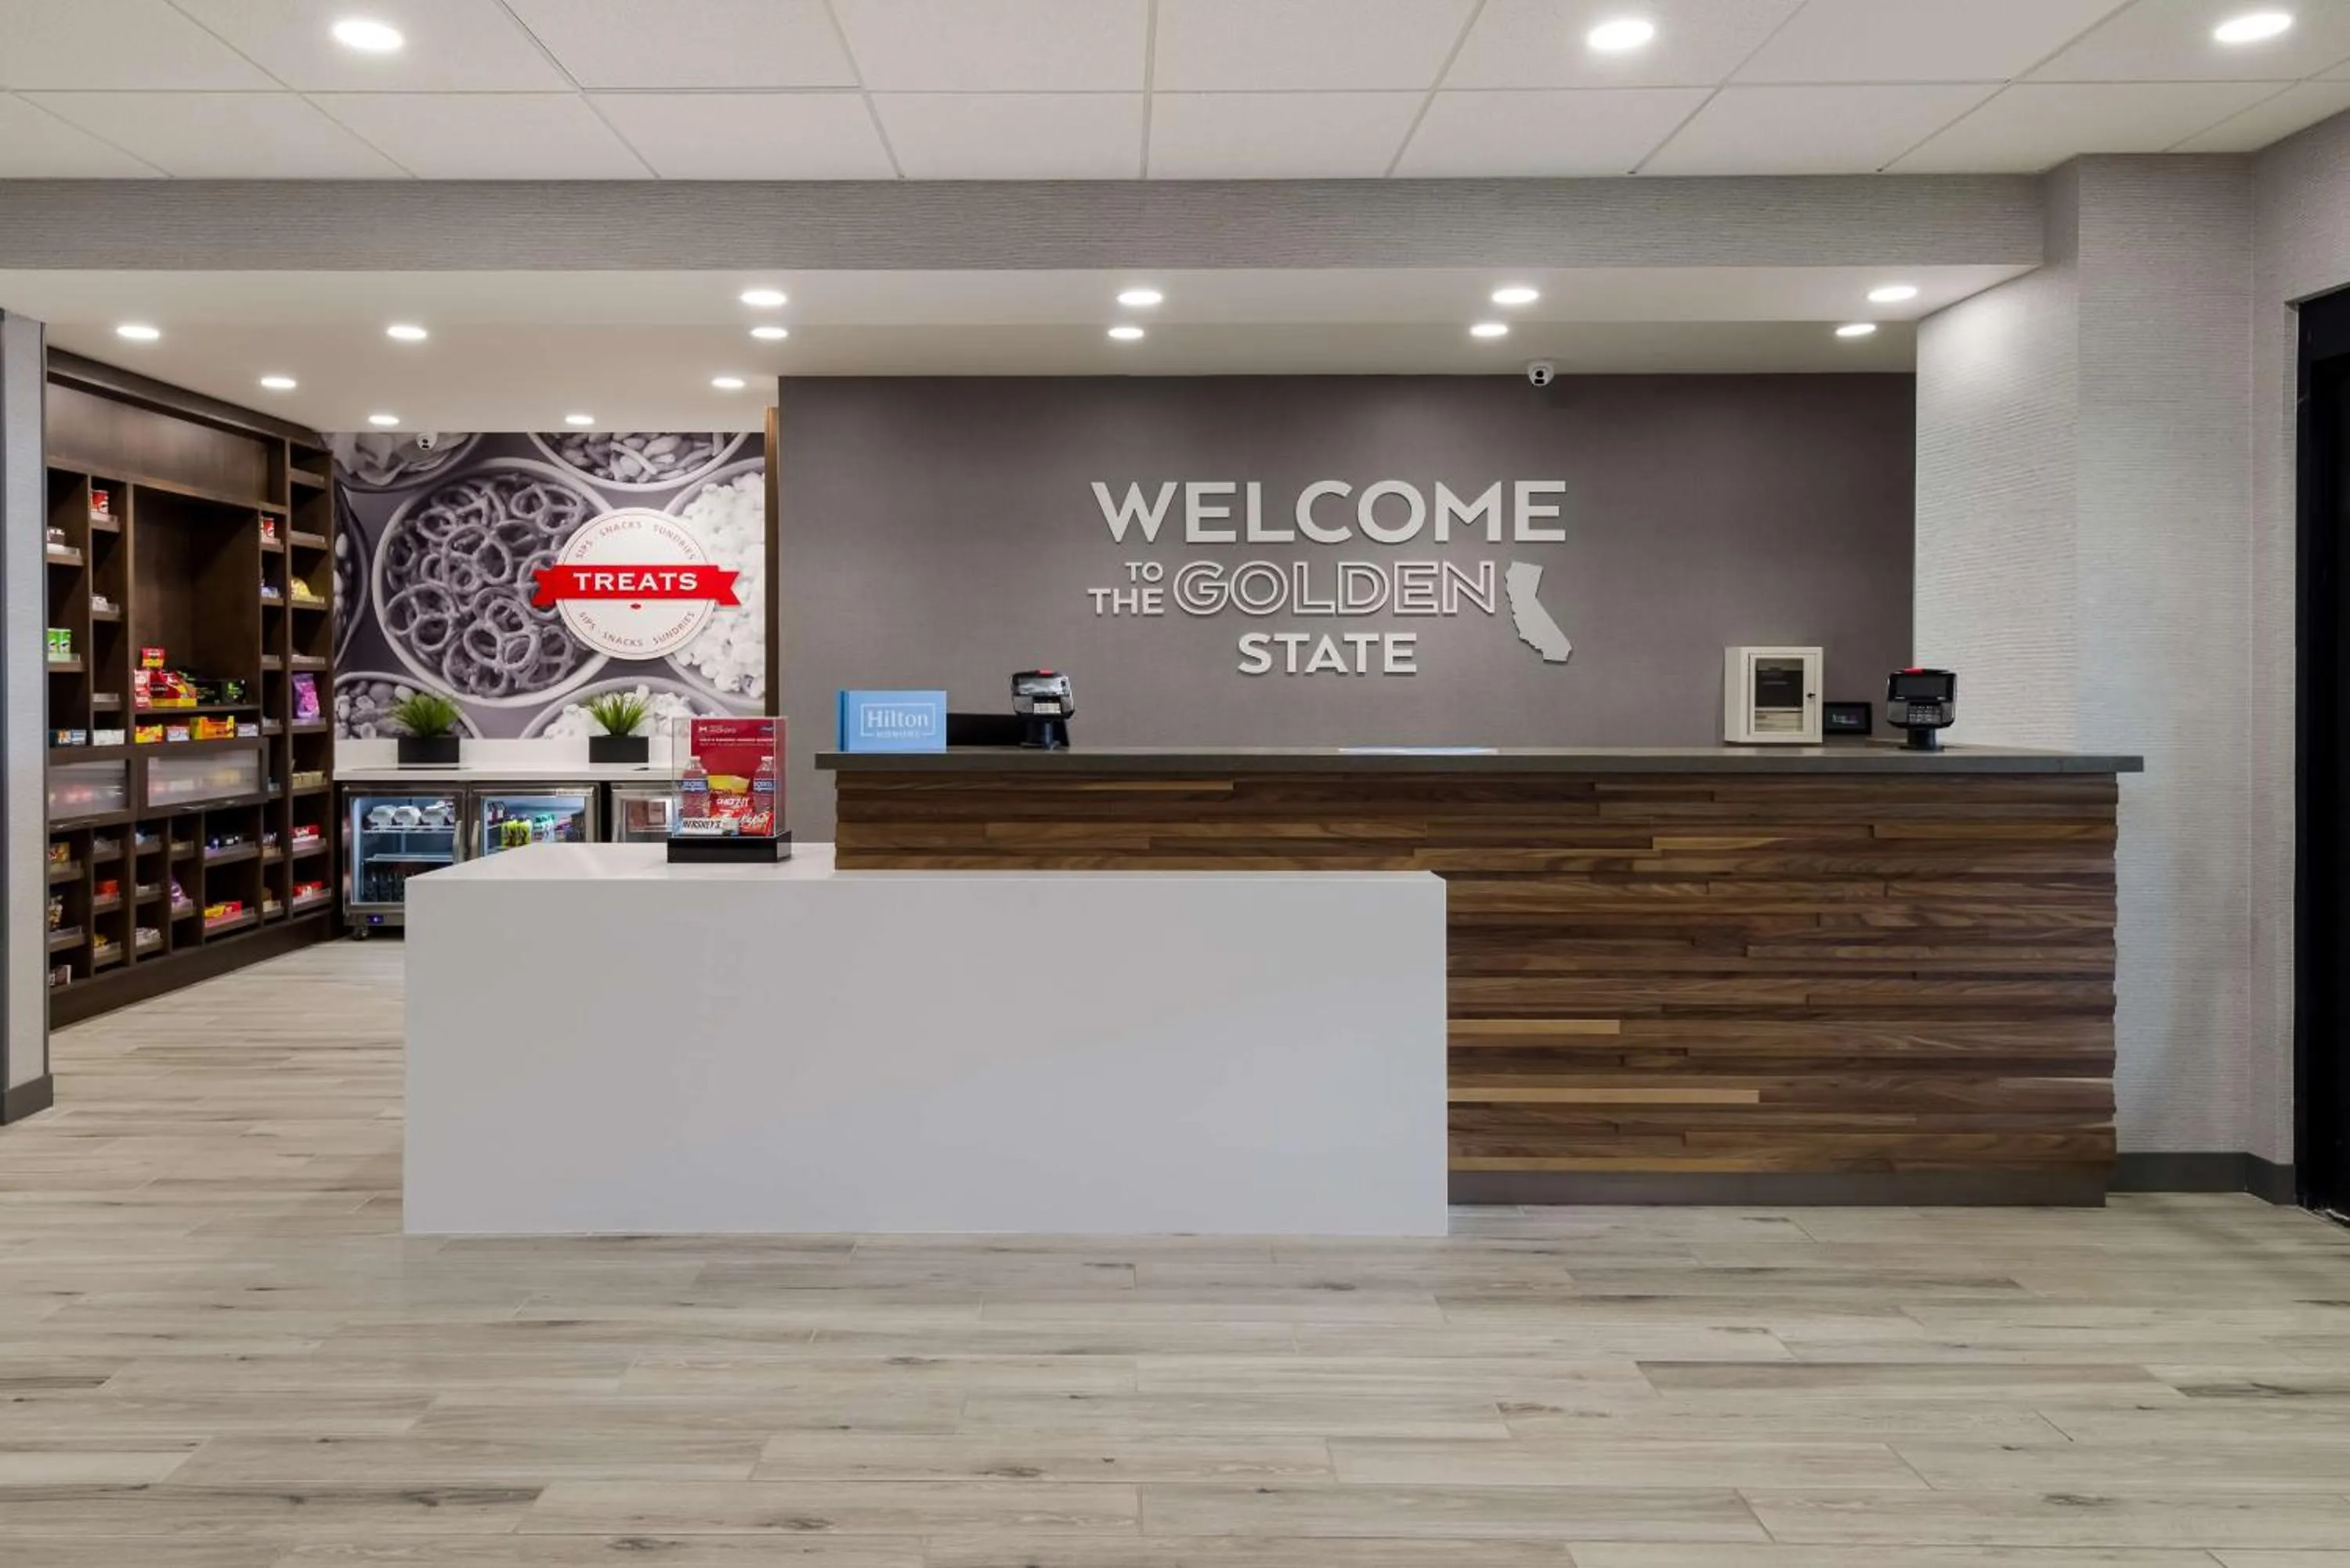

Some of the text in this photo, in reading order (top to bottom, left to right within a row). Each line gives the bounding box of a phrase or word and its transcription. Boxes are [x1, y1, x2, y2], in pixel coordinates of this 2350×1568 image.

[1091, 480, 1566, 544] WELCOME
[575, 521, 696, 560] SIPS SNACKS SUNDRIES
[573, 573, 698, 592] TREATS
[1088, 560, 1496, 616] THE GOLDEN
[1125, 562, 1163, 583] TO
[578, 611, 696, 648] SIPS SNACKS SUNDRIES
[1238, 632, 1417, 674] STATE
[867, 710, 929, 728] Hilton
